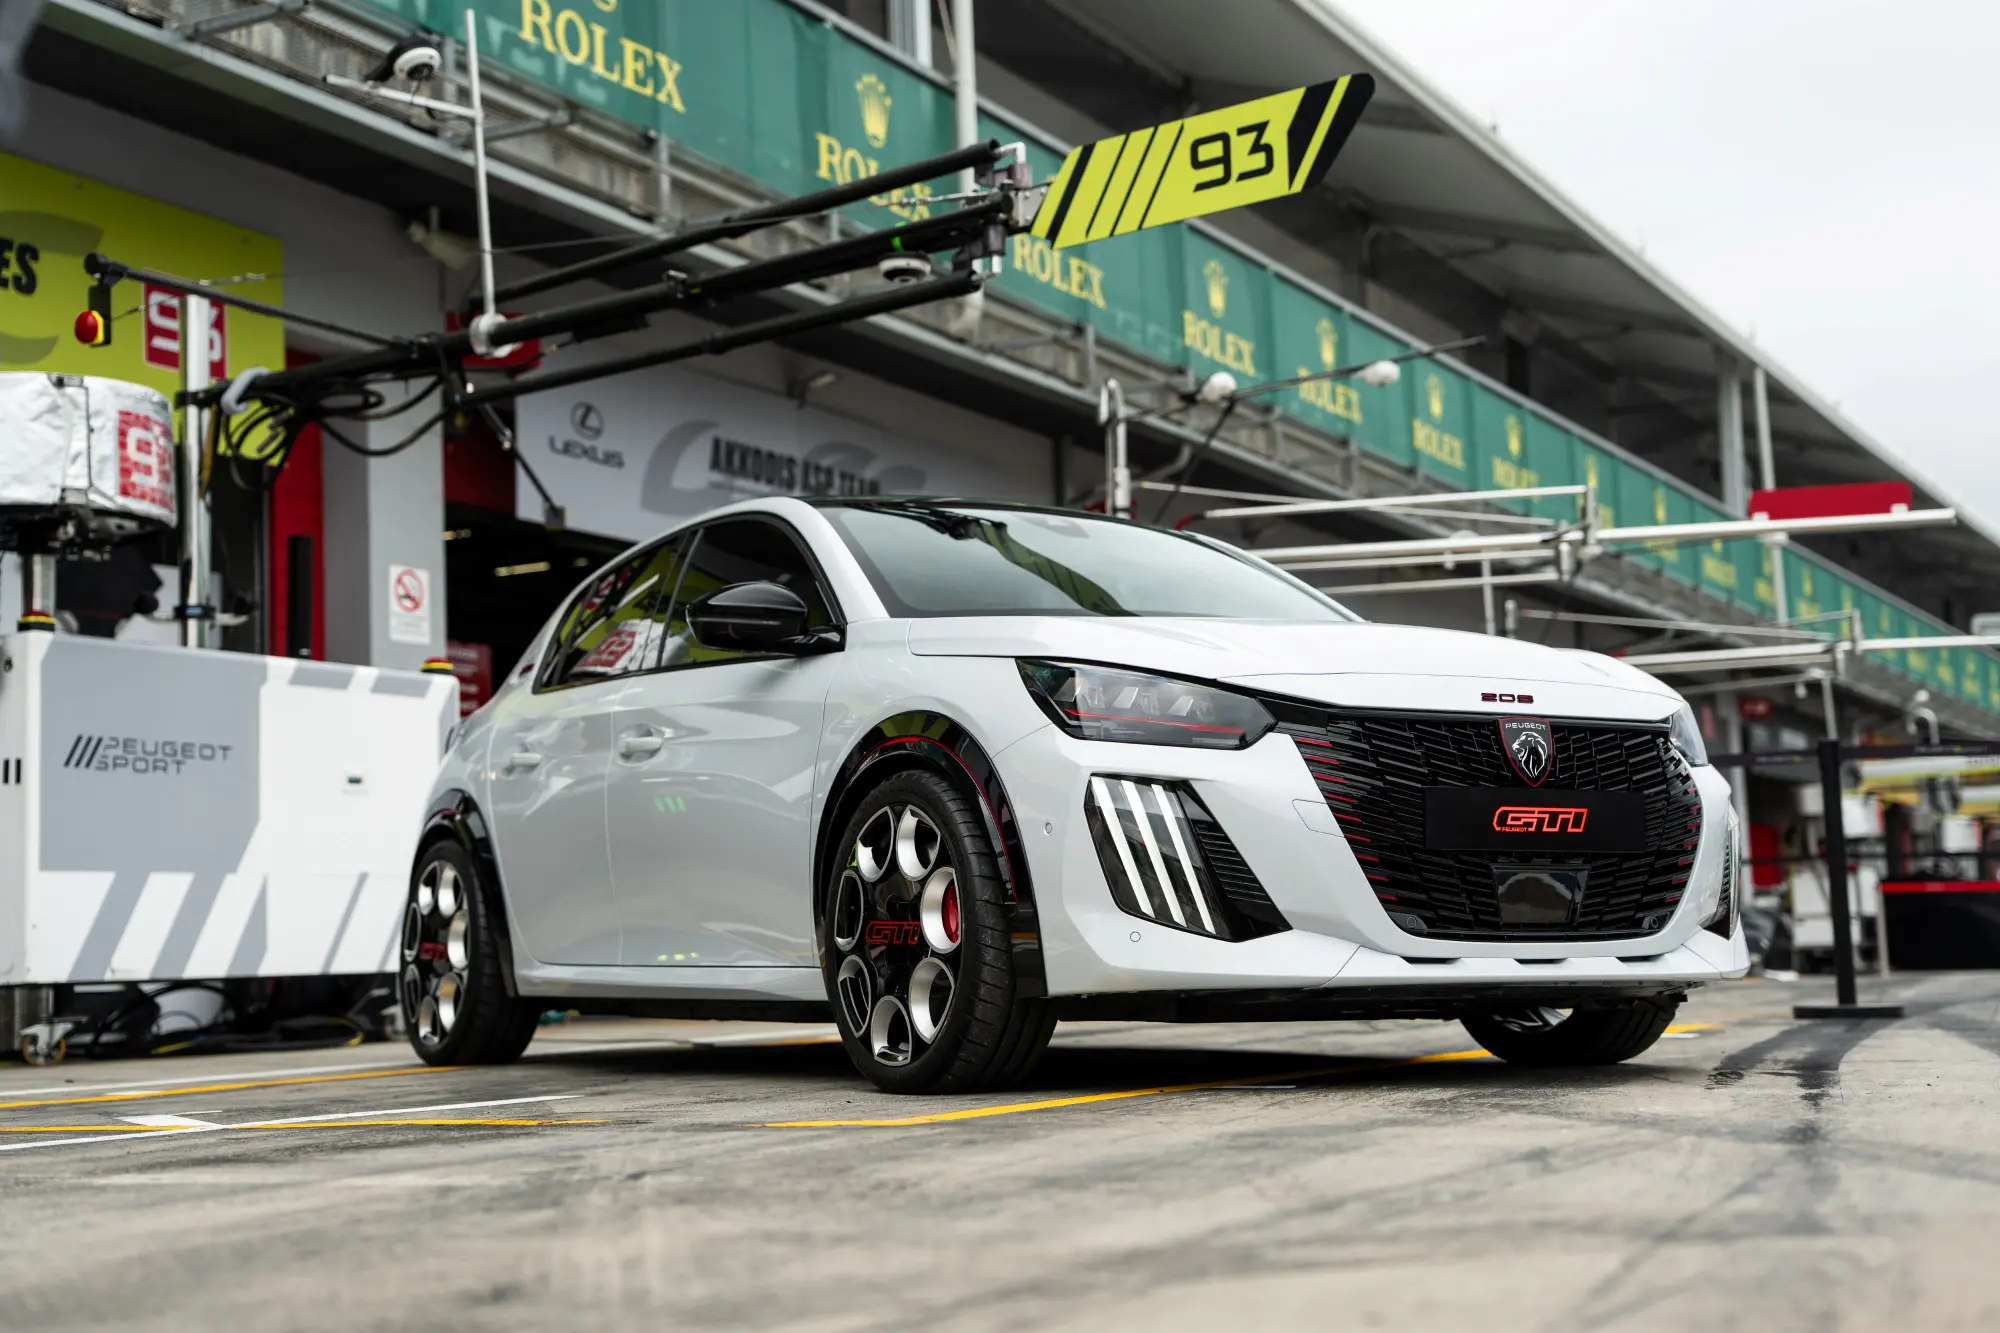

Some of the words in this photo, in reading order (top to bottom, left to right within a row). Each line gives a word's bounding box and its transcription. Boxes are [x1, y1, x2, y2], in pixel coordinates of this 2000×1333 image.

[519, 0, 686, 114] ROLEX
[1190, 119, 1274, 192] 93
[1012, 232, 1107, 310] ROLEX
[1183, 310, 1256, 377] ROLEX
[1297, 367, 1362, 425] ROLEX
[547, 434, 626, 471] LEXUS
[1481, 692, 1534, 704] 208
[103, 736, 232, 762] PEUGEOT
[1505, 722, 1547, 731] PEUGEOT
[94, 754, 186, 775] SPORT
